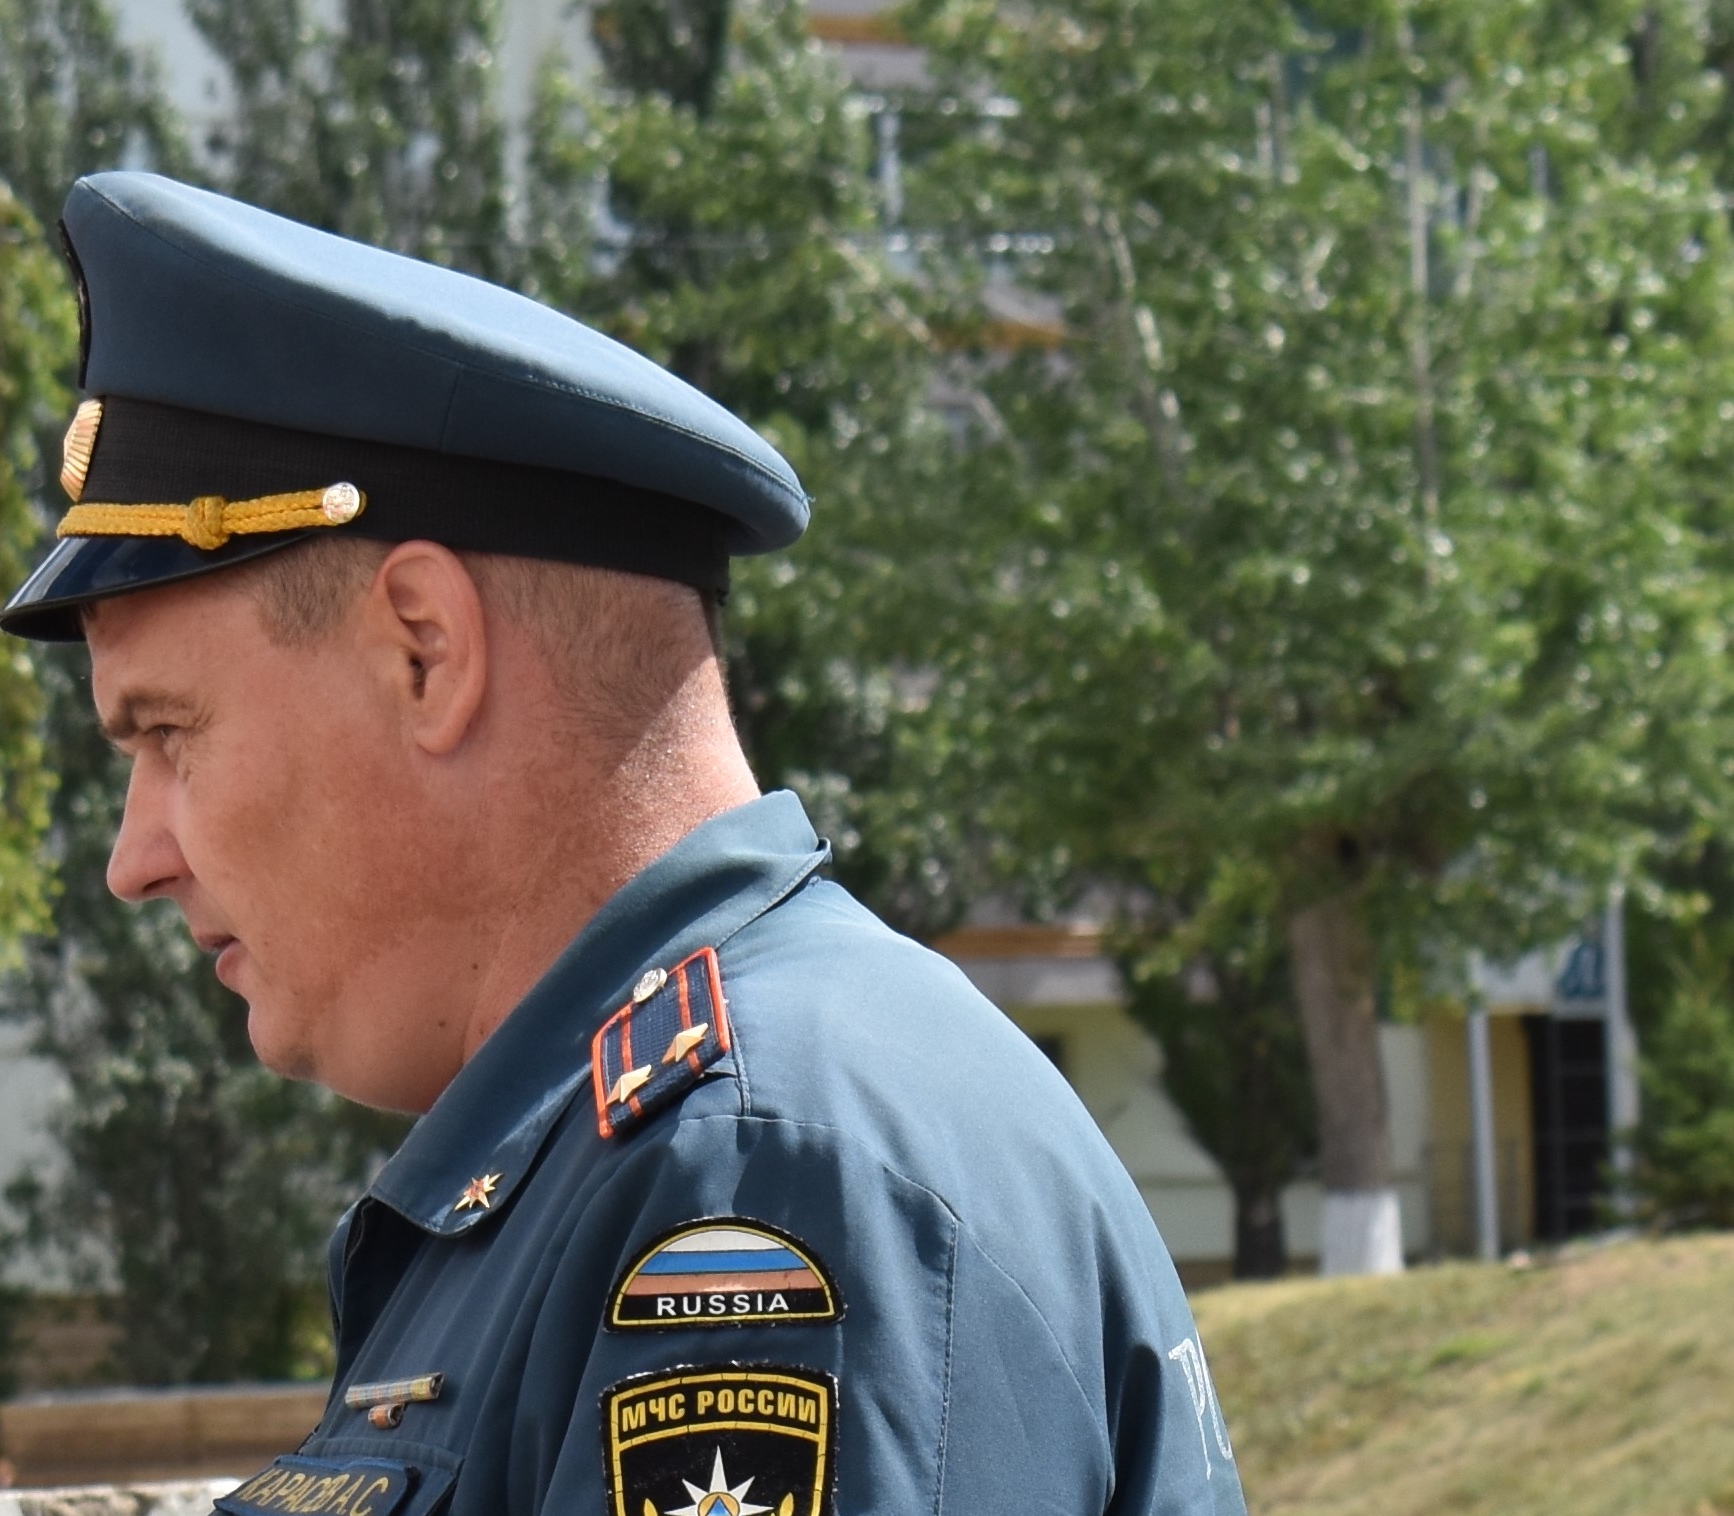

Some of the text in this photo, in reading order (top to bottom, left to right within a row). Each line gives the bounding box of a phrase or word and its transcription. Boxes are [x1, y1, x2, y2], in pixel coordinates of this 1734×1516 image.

[656, 1293, 789, 1317] RUSSIA
[622, 1389, 816, 1432] МЧС РОССИИ
